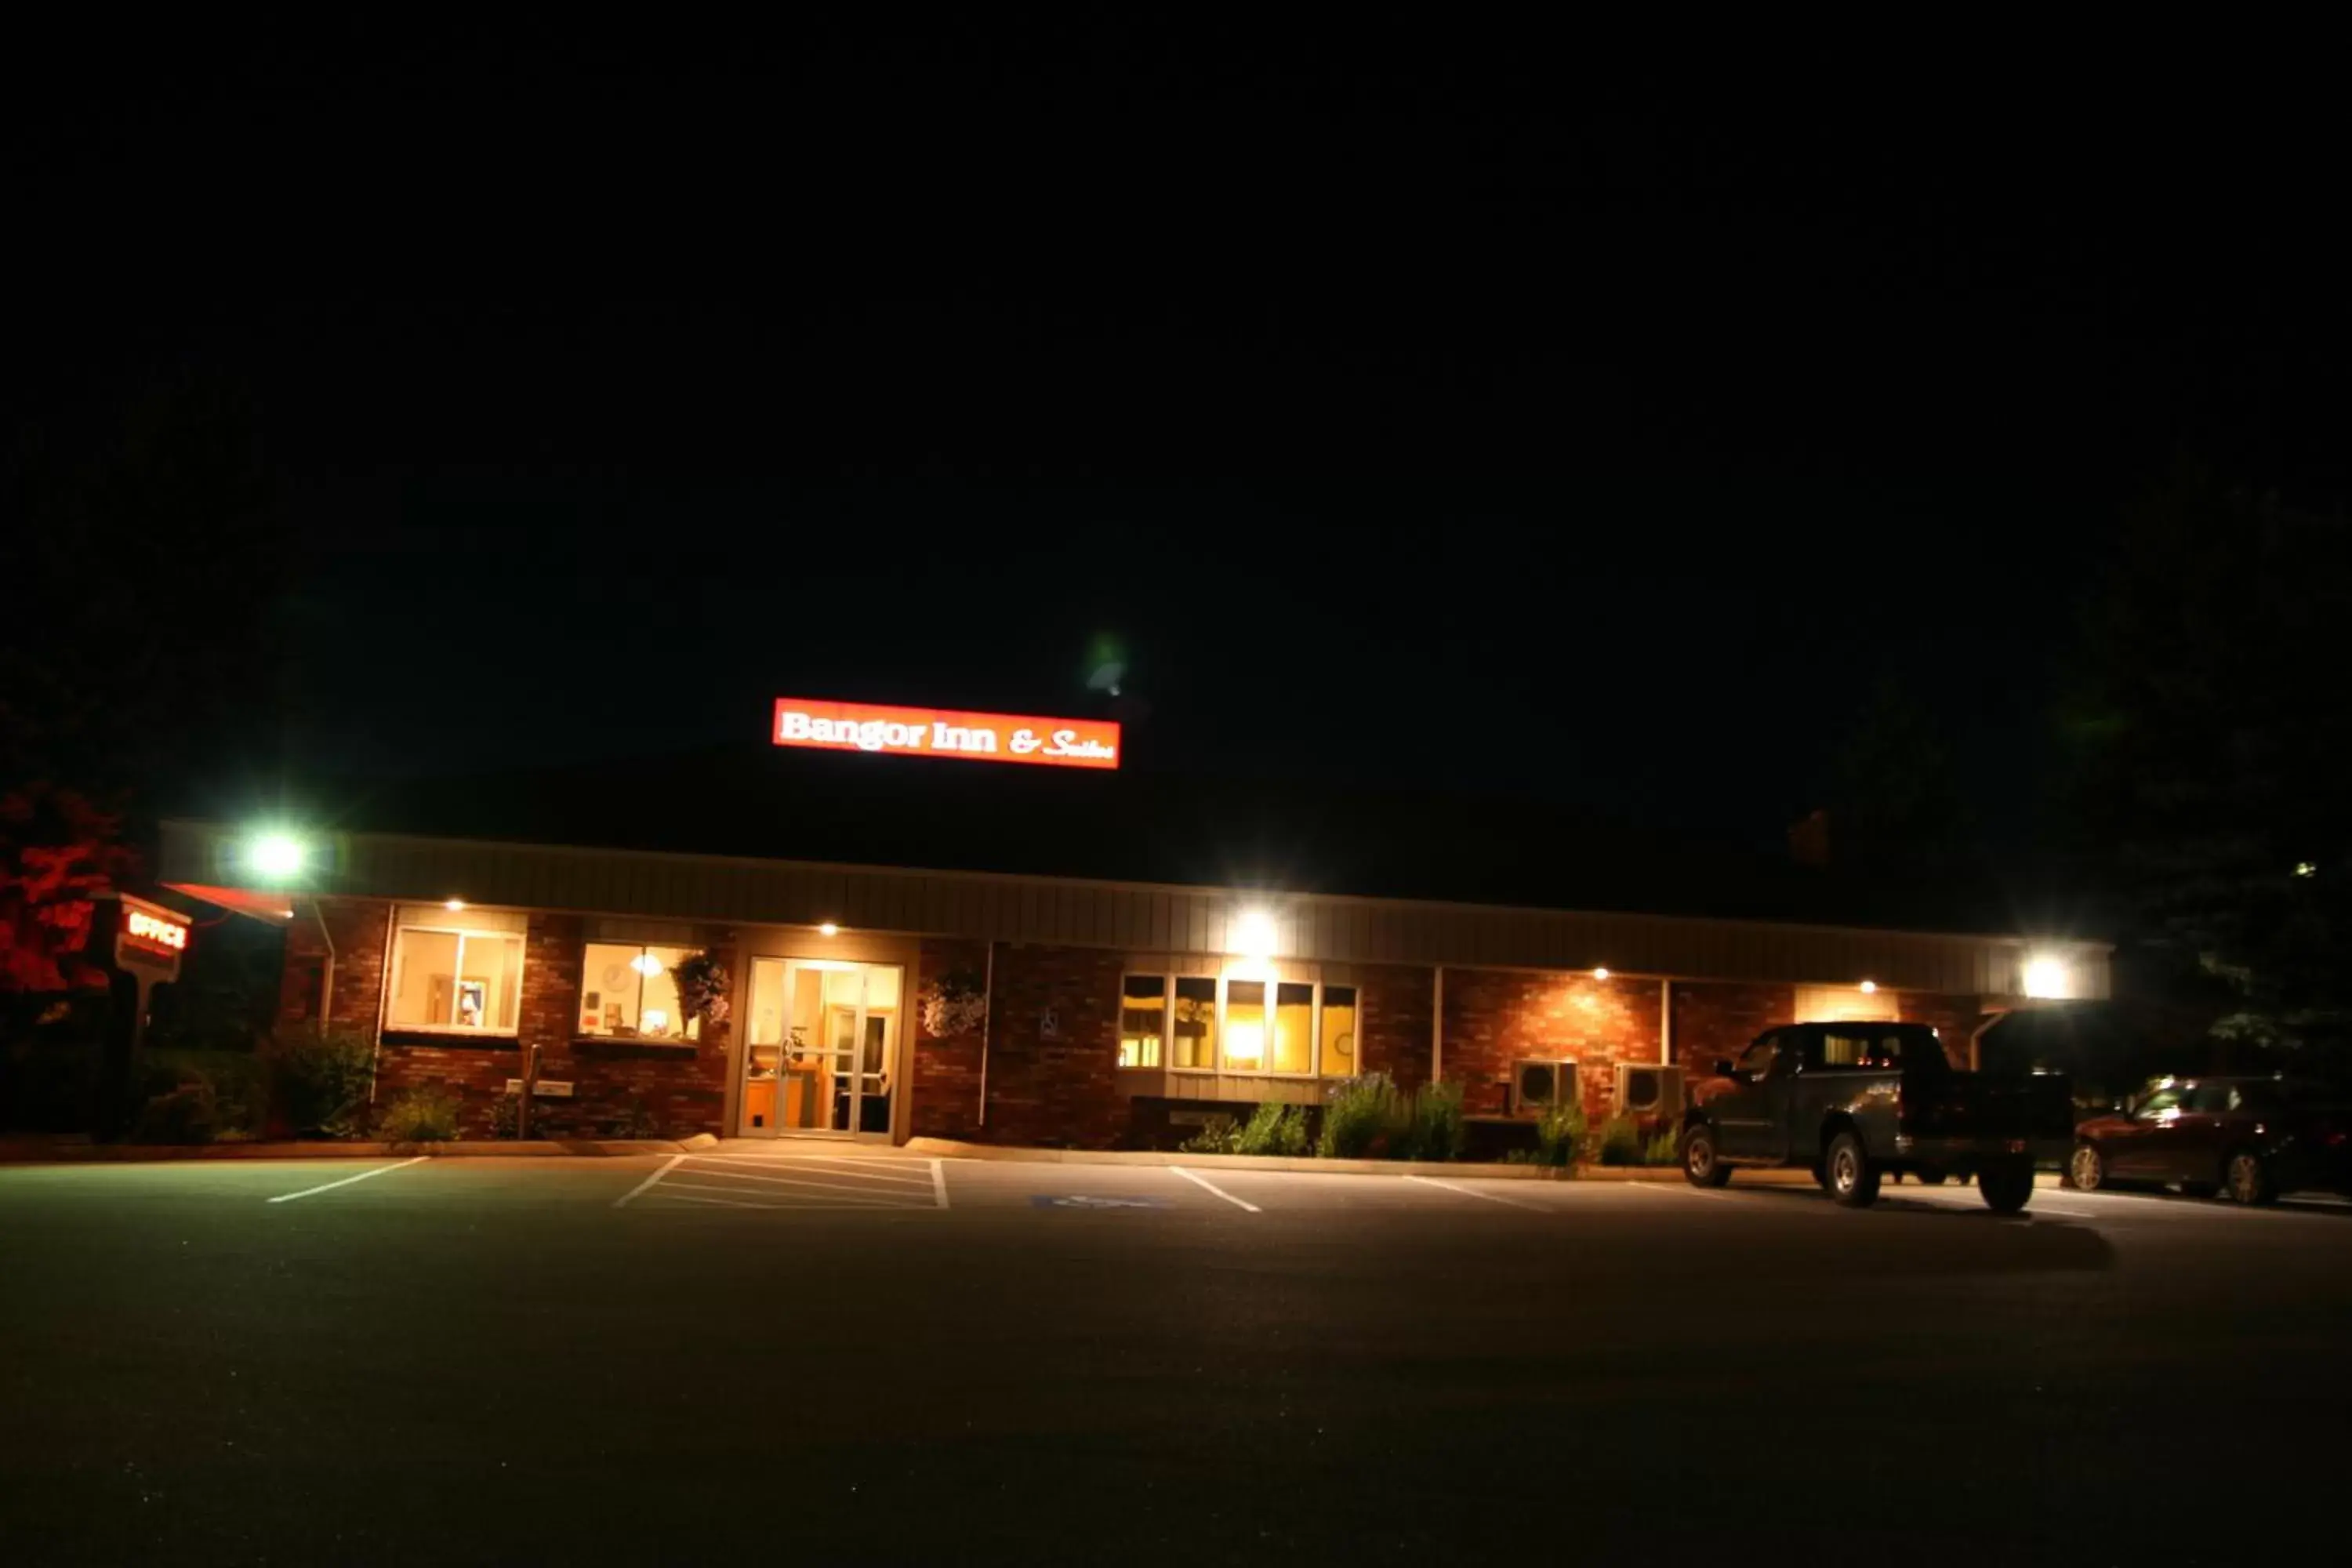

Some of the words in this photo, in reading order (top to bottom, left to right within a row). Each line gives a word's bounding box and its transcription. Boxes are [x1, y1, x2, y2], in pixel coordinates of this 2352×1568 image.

[779, 712, 927, 750] Bangor
[931, 722, 996, 752] Inn
[1009, 729, 1042, 753] &
[129, 912, 187, 949] OFFICE
